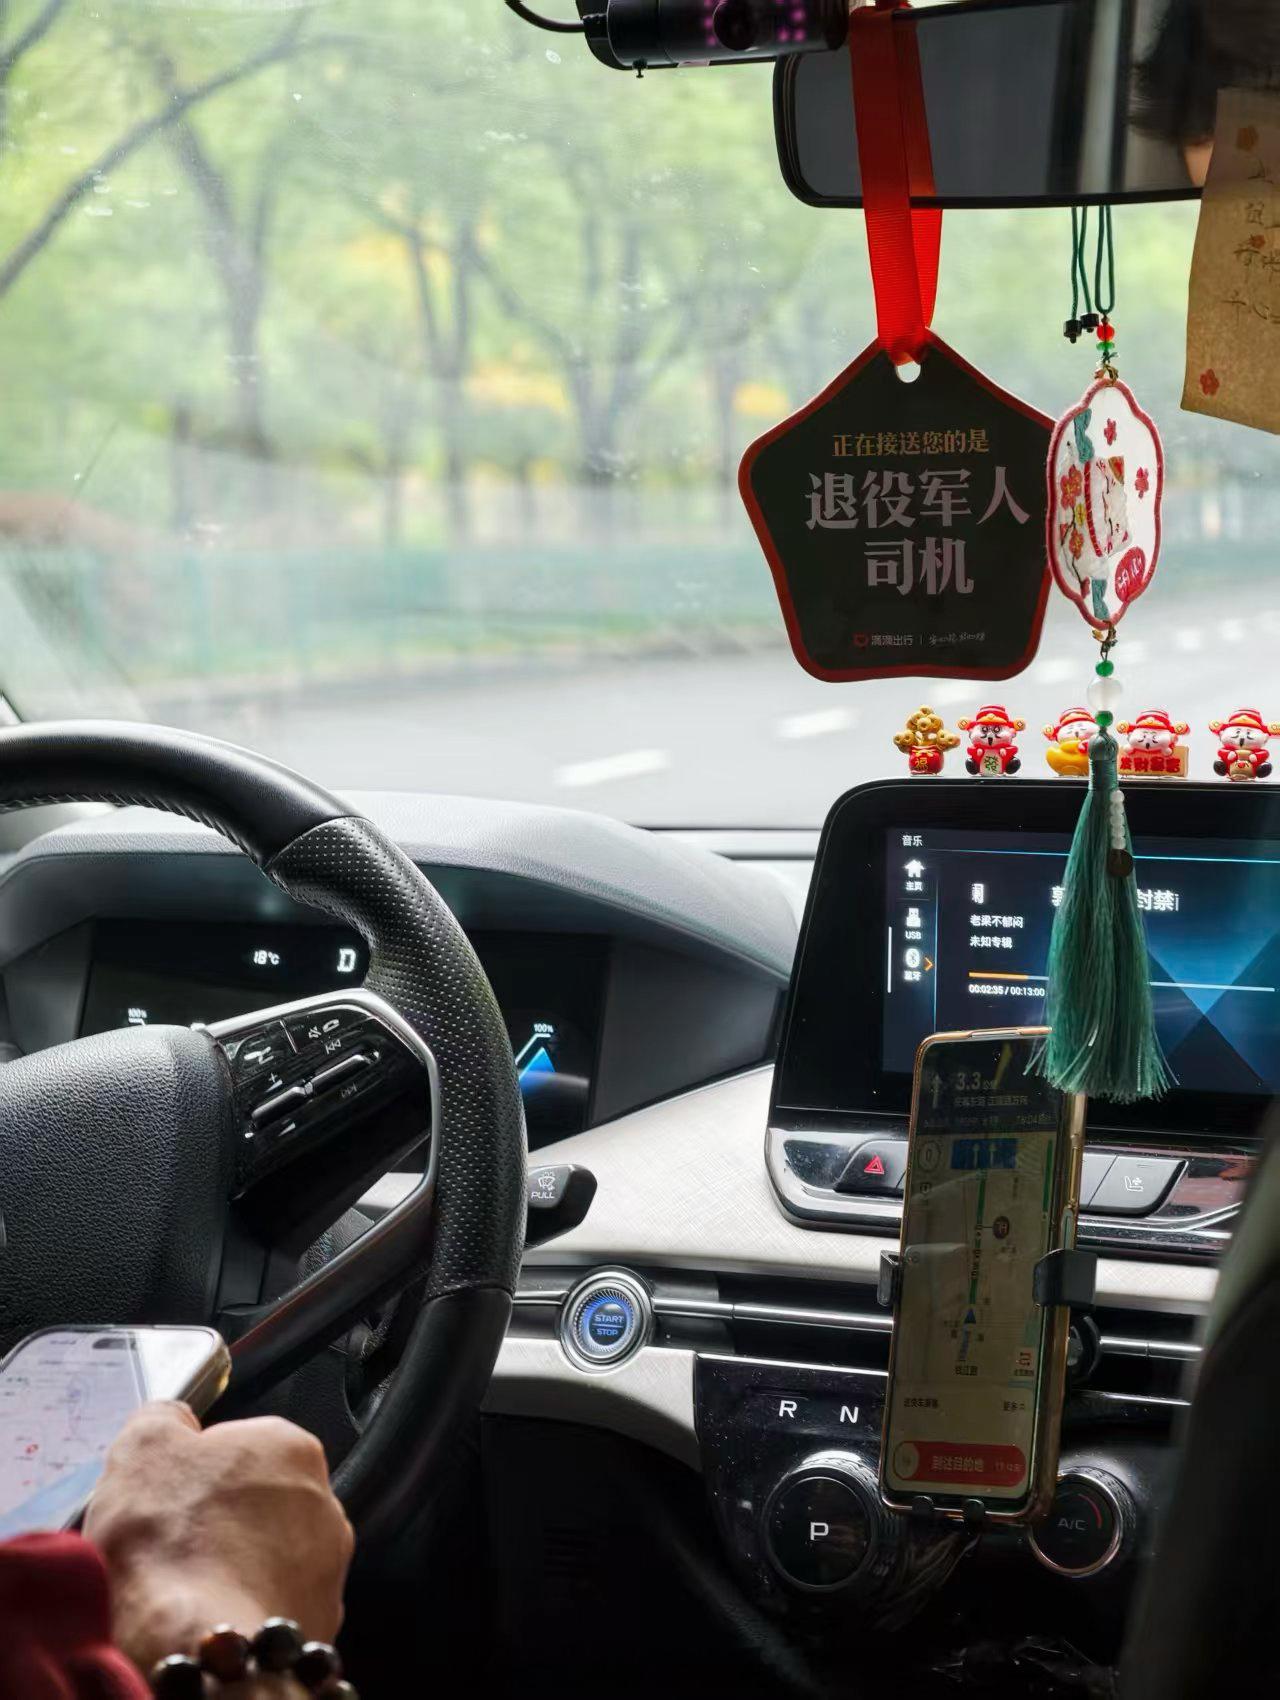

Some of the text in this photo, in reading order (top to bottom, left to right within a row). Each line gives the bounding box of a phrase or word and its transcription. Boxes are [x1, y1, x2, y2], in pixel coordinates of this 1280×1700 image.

[832, 428, 990, 457] 正在接送您的是
[805, 466, 1030, 531] 退役军人
[864, 537, 975, 596] 司机
[902, 835, 923, 848] 音乐
[905, 931, 922, 940] USB
[337, 948, 357, 973] D
[530, 1191, 556, 1200] PULL
[594, 1314, 625, 1323] START
[596, 1328, 619, 1337] STOP
[779, 1400, 798, 1418] R
[840, 1406, 860, 1424] N
[810, 1522, 830, 1541] P
[1058, 1516, 1088, 1532] A/C
